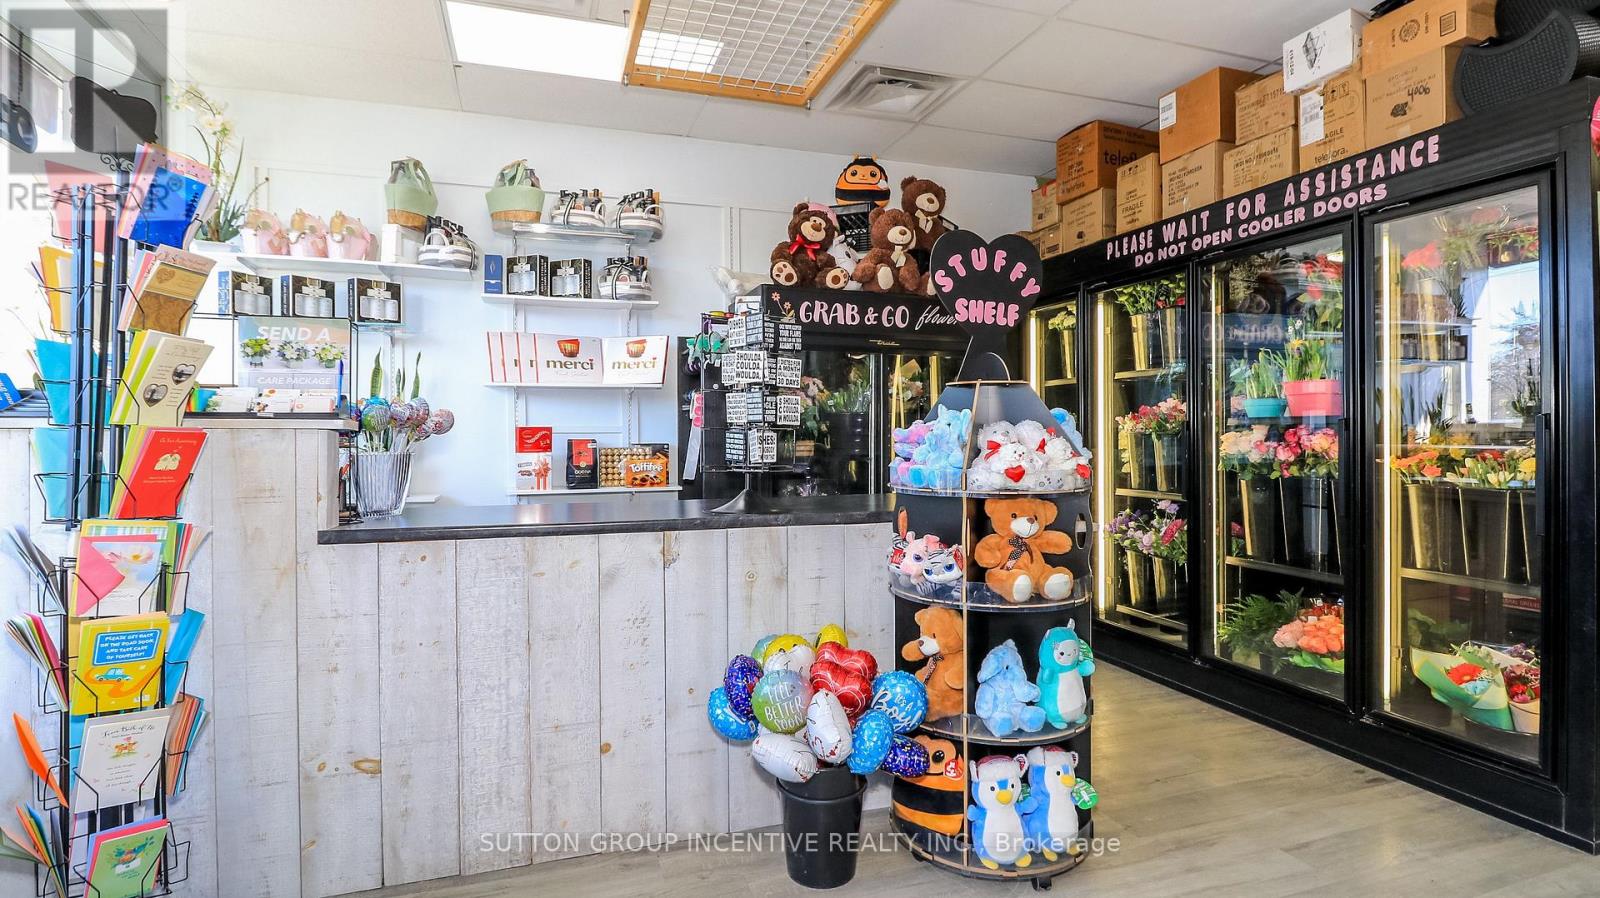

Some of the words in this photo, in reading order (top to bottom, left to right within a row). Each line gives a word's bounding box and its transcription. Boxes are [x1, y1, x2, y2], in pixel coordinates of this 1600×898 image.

[1408, 84, 1430, 102] 4006
[1325, 127, 1345, 140] AGILE
[1106, 229, 1153, 261] PLEASE
[1162, 210, 1210, 244] WAIT
[1225, 193, 1266, 225] FOR
[1284, 134, 1440, 207] ASSISTANCE
[1135, 252, 1154, 268] DO
[1158, 241, 1187, 261] NOT
[1191, 228, 1233, 251] OPEN
[1238, 206, 1306, 238] COOLER
[1313, 183, 1388, 218] DOORS
[934, 247, 1041, 297] STUFFY
[800, 300, 861, 326] GRAB
[864, 307, 879, 326] &
[881, 305, 910, 329] GO
[914, 304, 958, 331] flowe
[955, 298, 1019, 327] SHELF
[257, 326, 313, 342] SEND
[315, 327, 331, 341] A
[546, 357, 594, 370] merci
[611, 357, 657, 370] merci
[783, 365, 800, 373] MONTH
[257, 376, 285, 385] CARE
[287, 377, 332, 385] PACKAGE
[778, 377, 784, 385] 30
[786, 379, 800, 387] DAYS
[629, 462, 664, 473] Toffifee
[764, 697, 804, 721] BETTER
